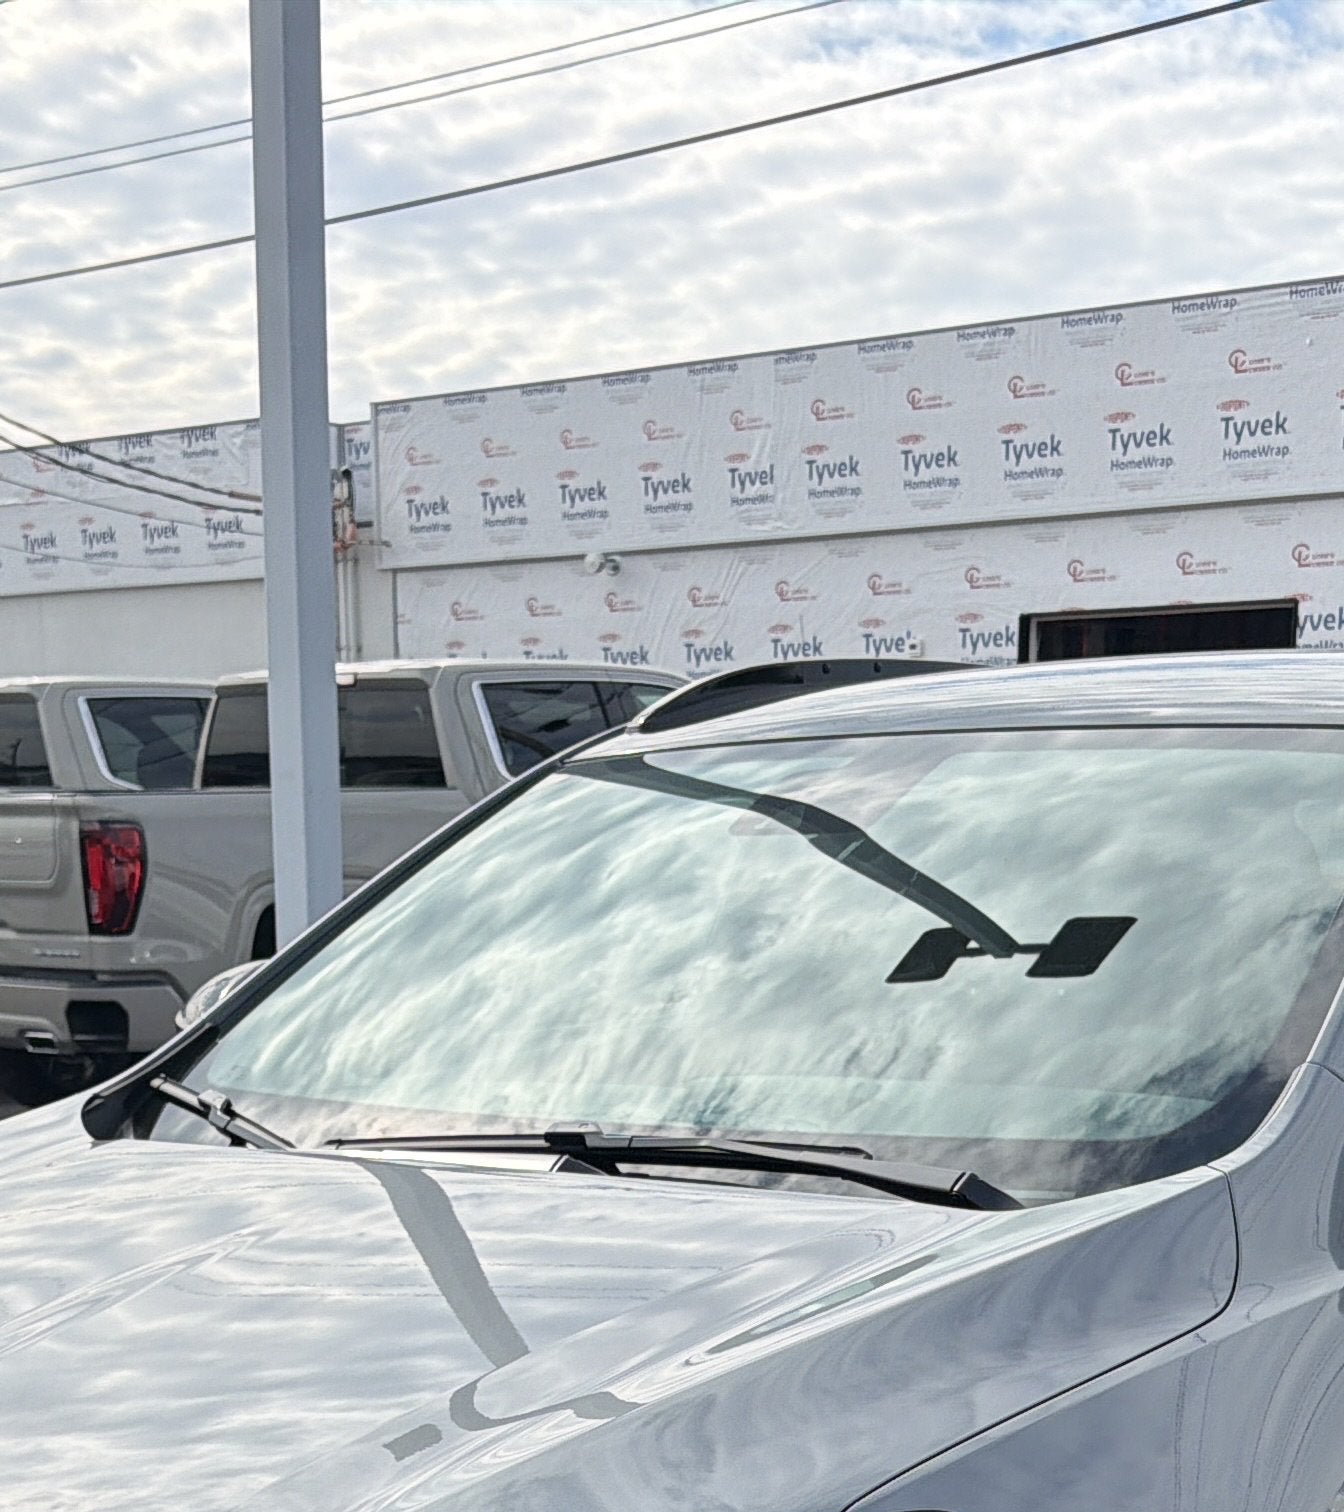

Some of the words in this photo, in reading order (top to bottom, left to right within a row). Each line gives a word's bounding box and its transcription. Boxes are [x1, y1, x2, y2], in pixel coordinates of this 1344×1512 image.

[1171, 298, 1237, 315] HomeWrap
[1061, 313, 1123, 328] HomeWrap
[179, 426, 216, 451] Tyvek
[1108, 423, 1171, 456] Tyvek
[1221, 411, 1287, 445] Tyvek
[901, 445, 958, 477] Tyvek
[1001, 434, 1061, 467] Tyvek
[1223, 445, 1289, 461] HomeWrap
[805, 455, 860, 486] Tyvek
[1004, 467, 1063, 481] HomeWrap
[1110, 456, 1174, 472] HomeWrap
[559, 480, 607, 506] Tyvek
[641, 472, 691, 502] Tyvek
[406, 495, 449, 522] Tyvek
[481, 488, 526, 515] Tyvek
[81, 526, 116, 550] Tyvek
[141, 523, 178, 544] Tyvek
[205, 516, 243, 539] Tyvek
[23, 532, 56, 555] Tyvek
[684, 641, 734, 662] Tyvek
[771, 636, 822, 660] Tyvek
[959, 625, 1015, 655] Tyvek
